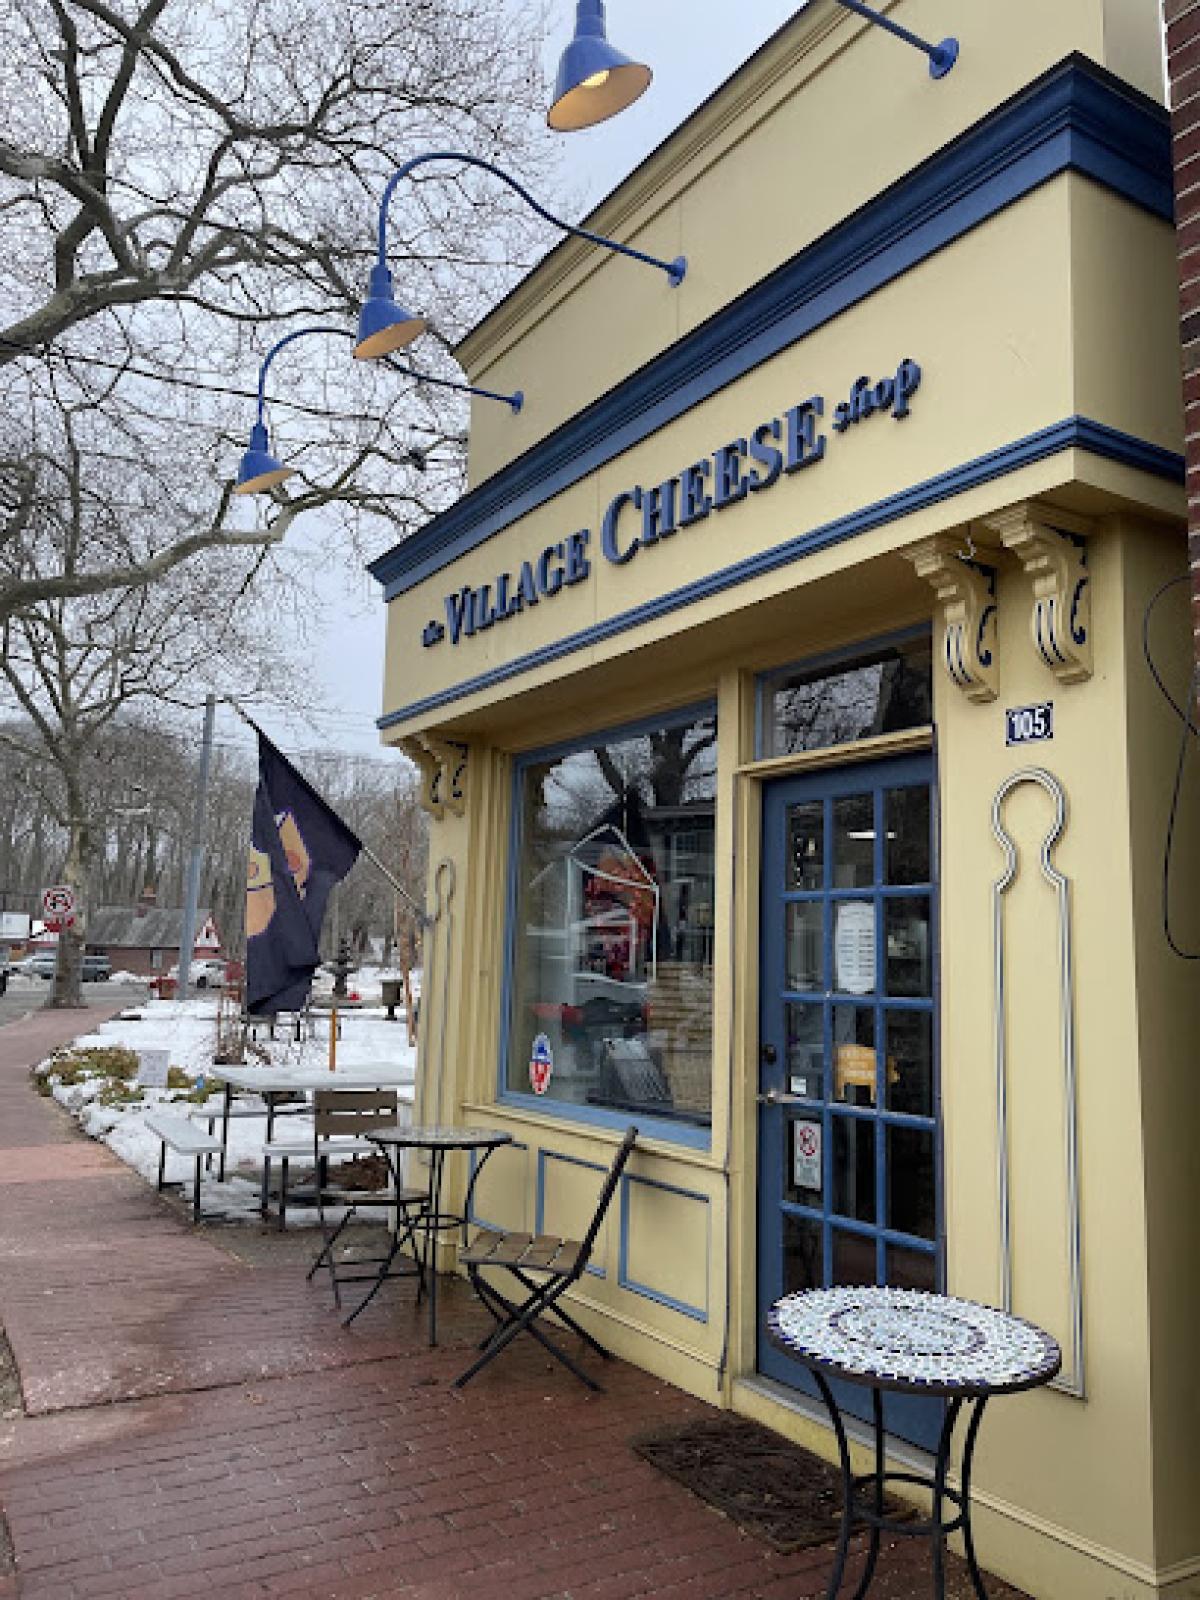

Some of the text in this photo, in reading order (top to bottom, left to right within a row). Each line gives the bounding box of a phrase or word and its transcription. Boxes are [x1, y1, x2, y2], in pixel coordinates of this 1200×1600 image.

[422, 358, 922, 647] the VILLAGE CHEESE shop
[1011, 708, 1046, 739] 105
